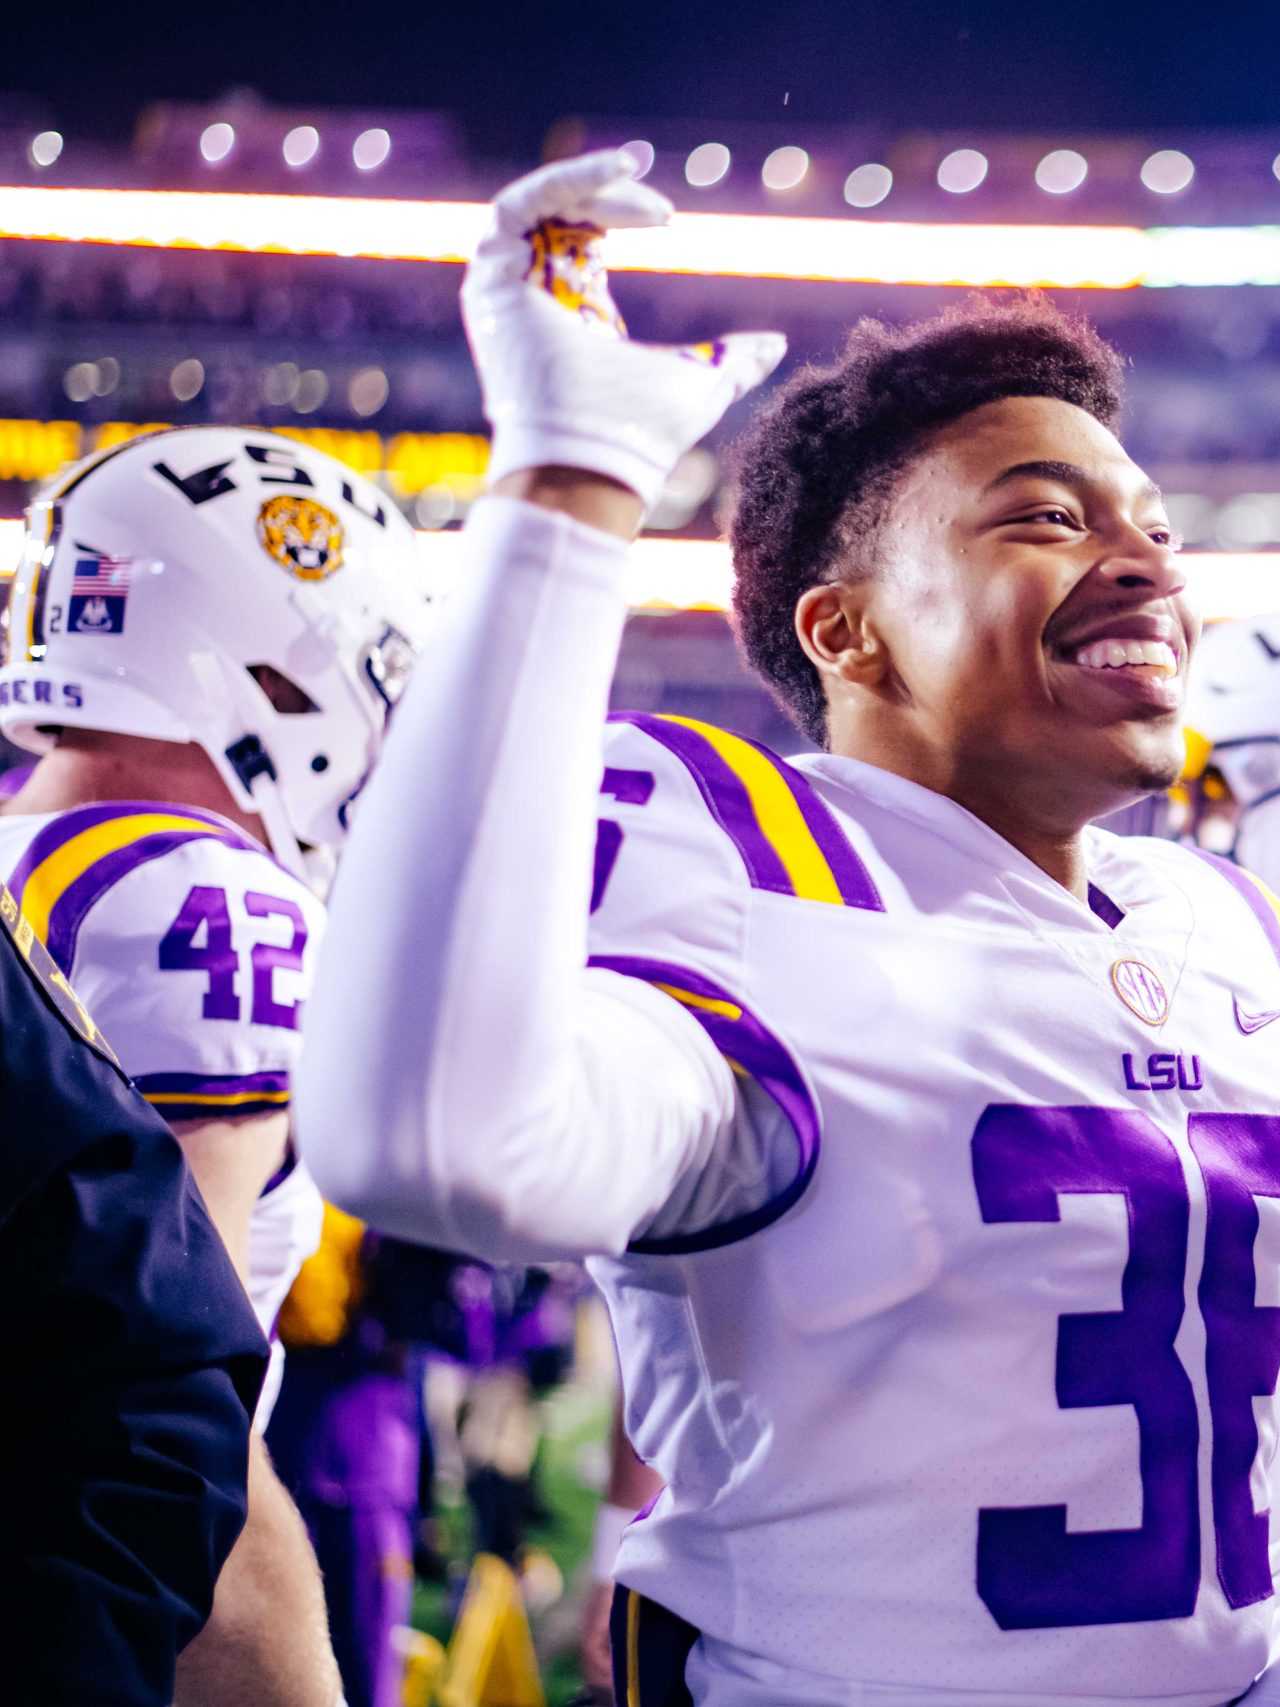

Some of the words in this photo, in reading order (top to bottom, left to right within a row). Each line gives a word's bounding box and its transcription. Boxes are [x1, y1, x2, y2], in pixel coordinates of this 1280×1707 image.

[151, 444, 388, 528] LSU
[159, 885, 309, 1030] 42
[1122, 1053, 1203, 1091] LSU
